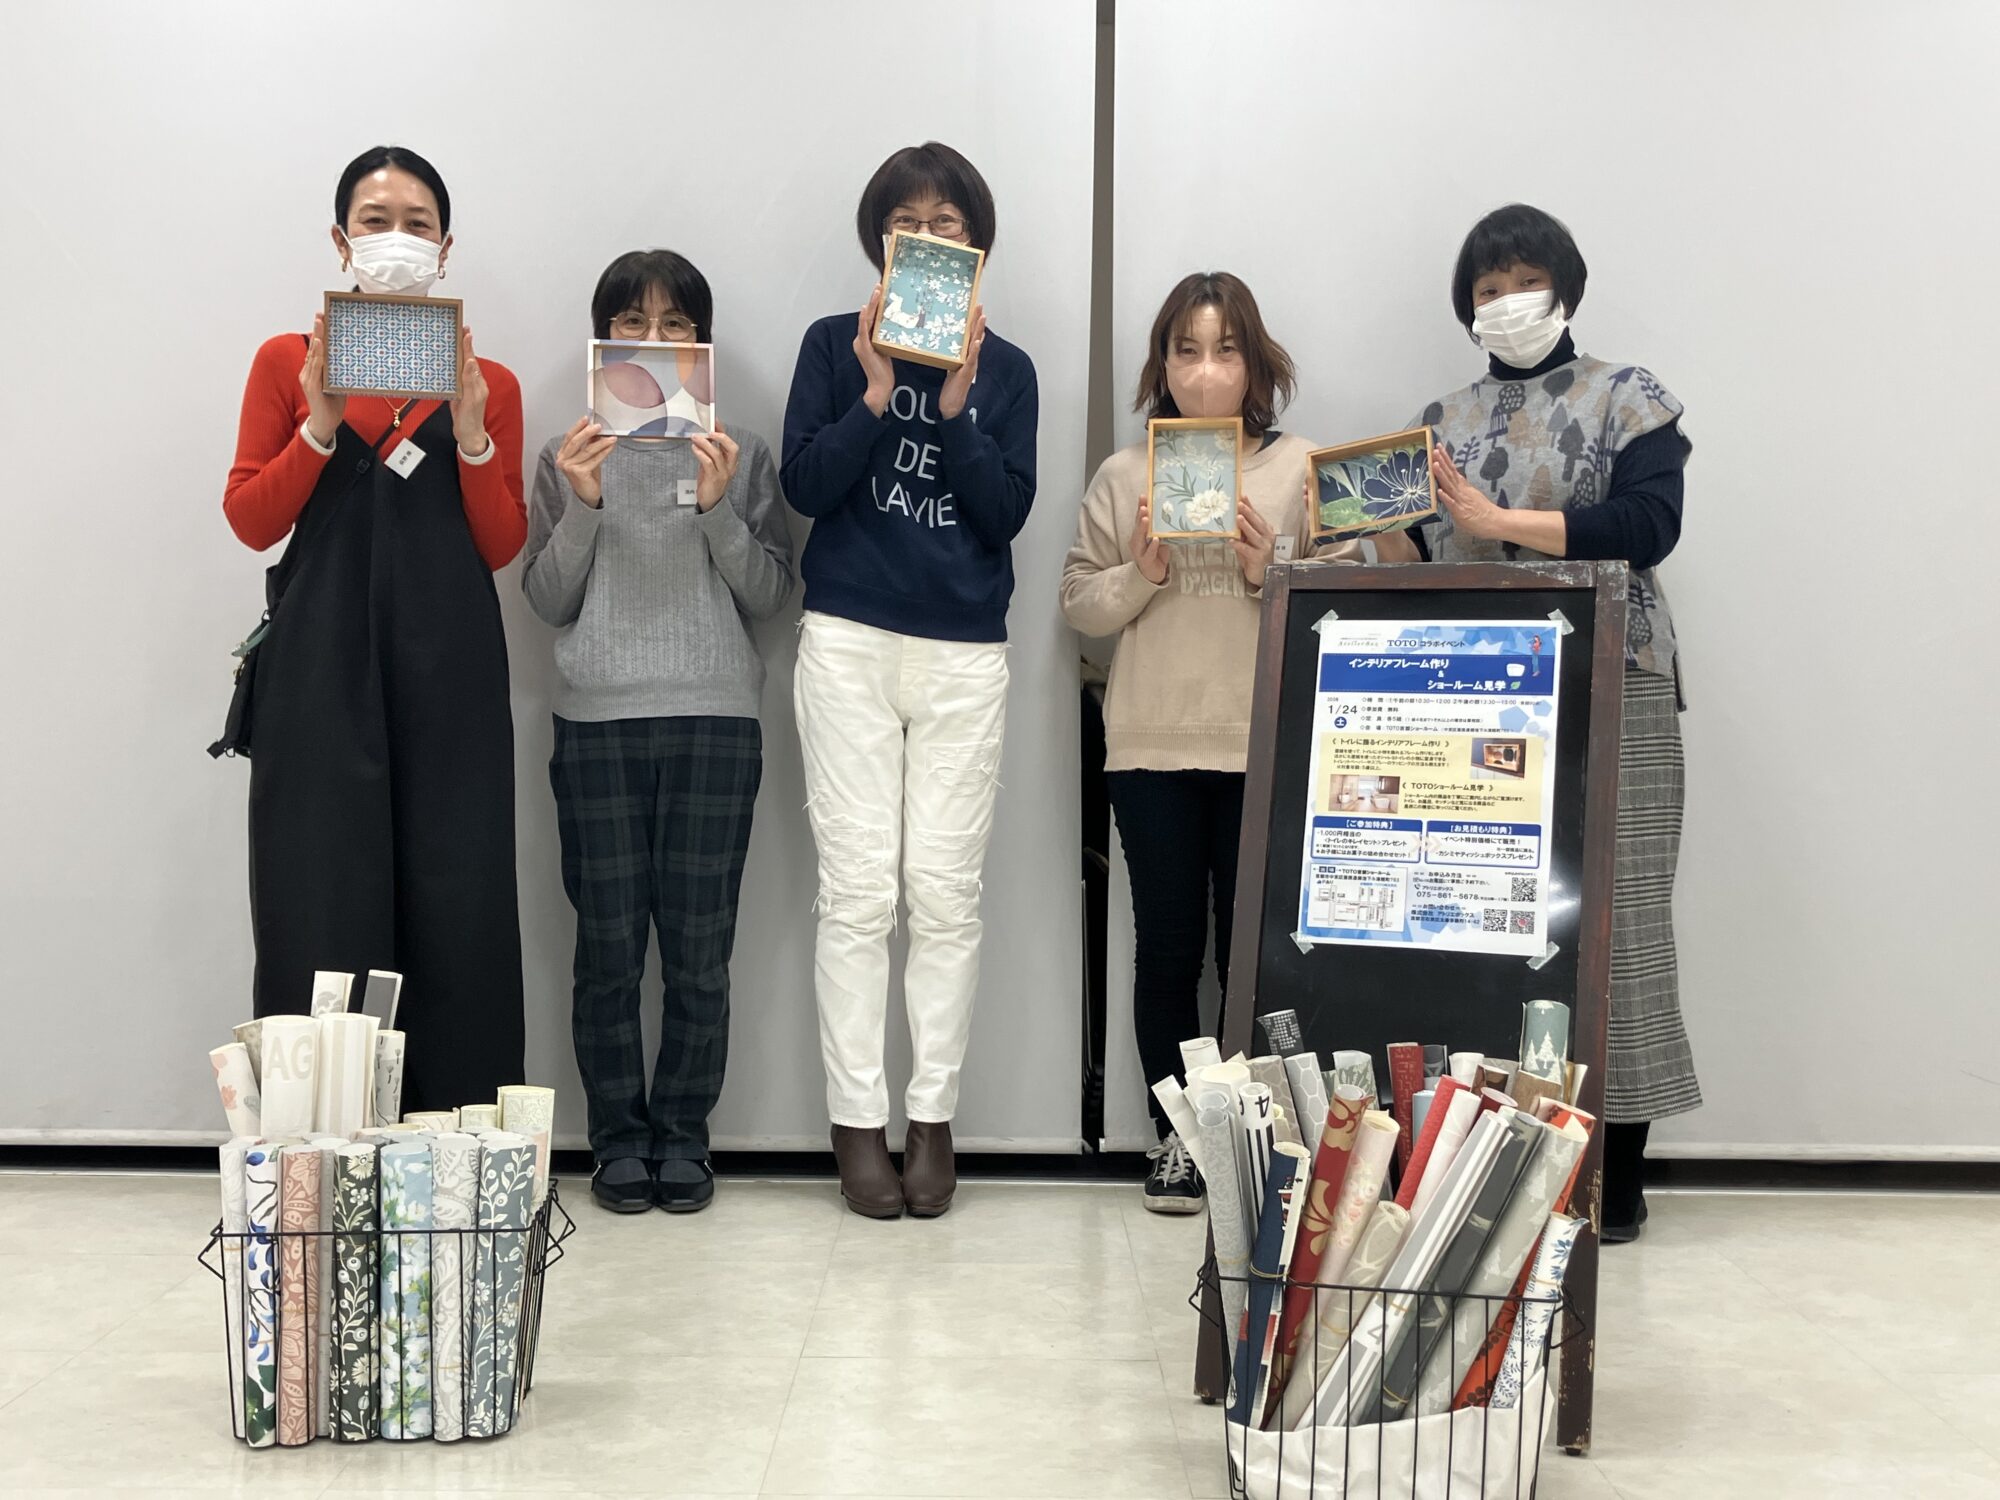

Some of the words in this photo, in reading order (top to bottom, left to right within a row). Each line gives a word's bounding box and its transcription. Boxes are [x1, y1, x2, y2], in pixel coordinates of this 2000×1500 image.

[893, 436, 942, 481] DE
[1387, 639, 1417, 647] TOTO
[1420, 640, 1466, 648] コラボイベント
[1348, 658, 1450, 669] インテリアフレーム作り
[1427, 680, 1507, 692] ショールーム見学
[1328, 704, 1358, 714] 1/24
[1335, 717, 1346, 728] 土
